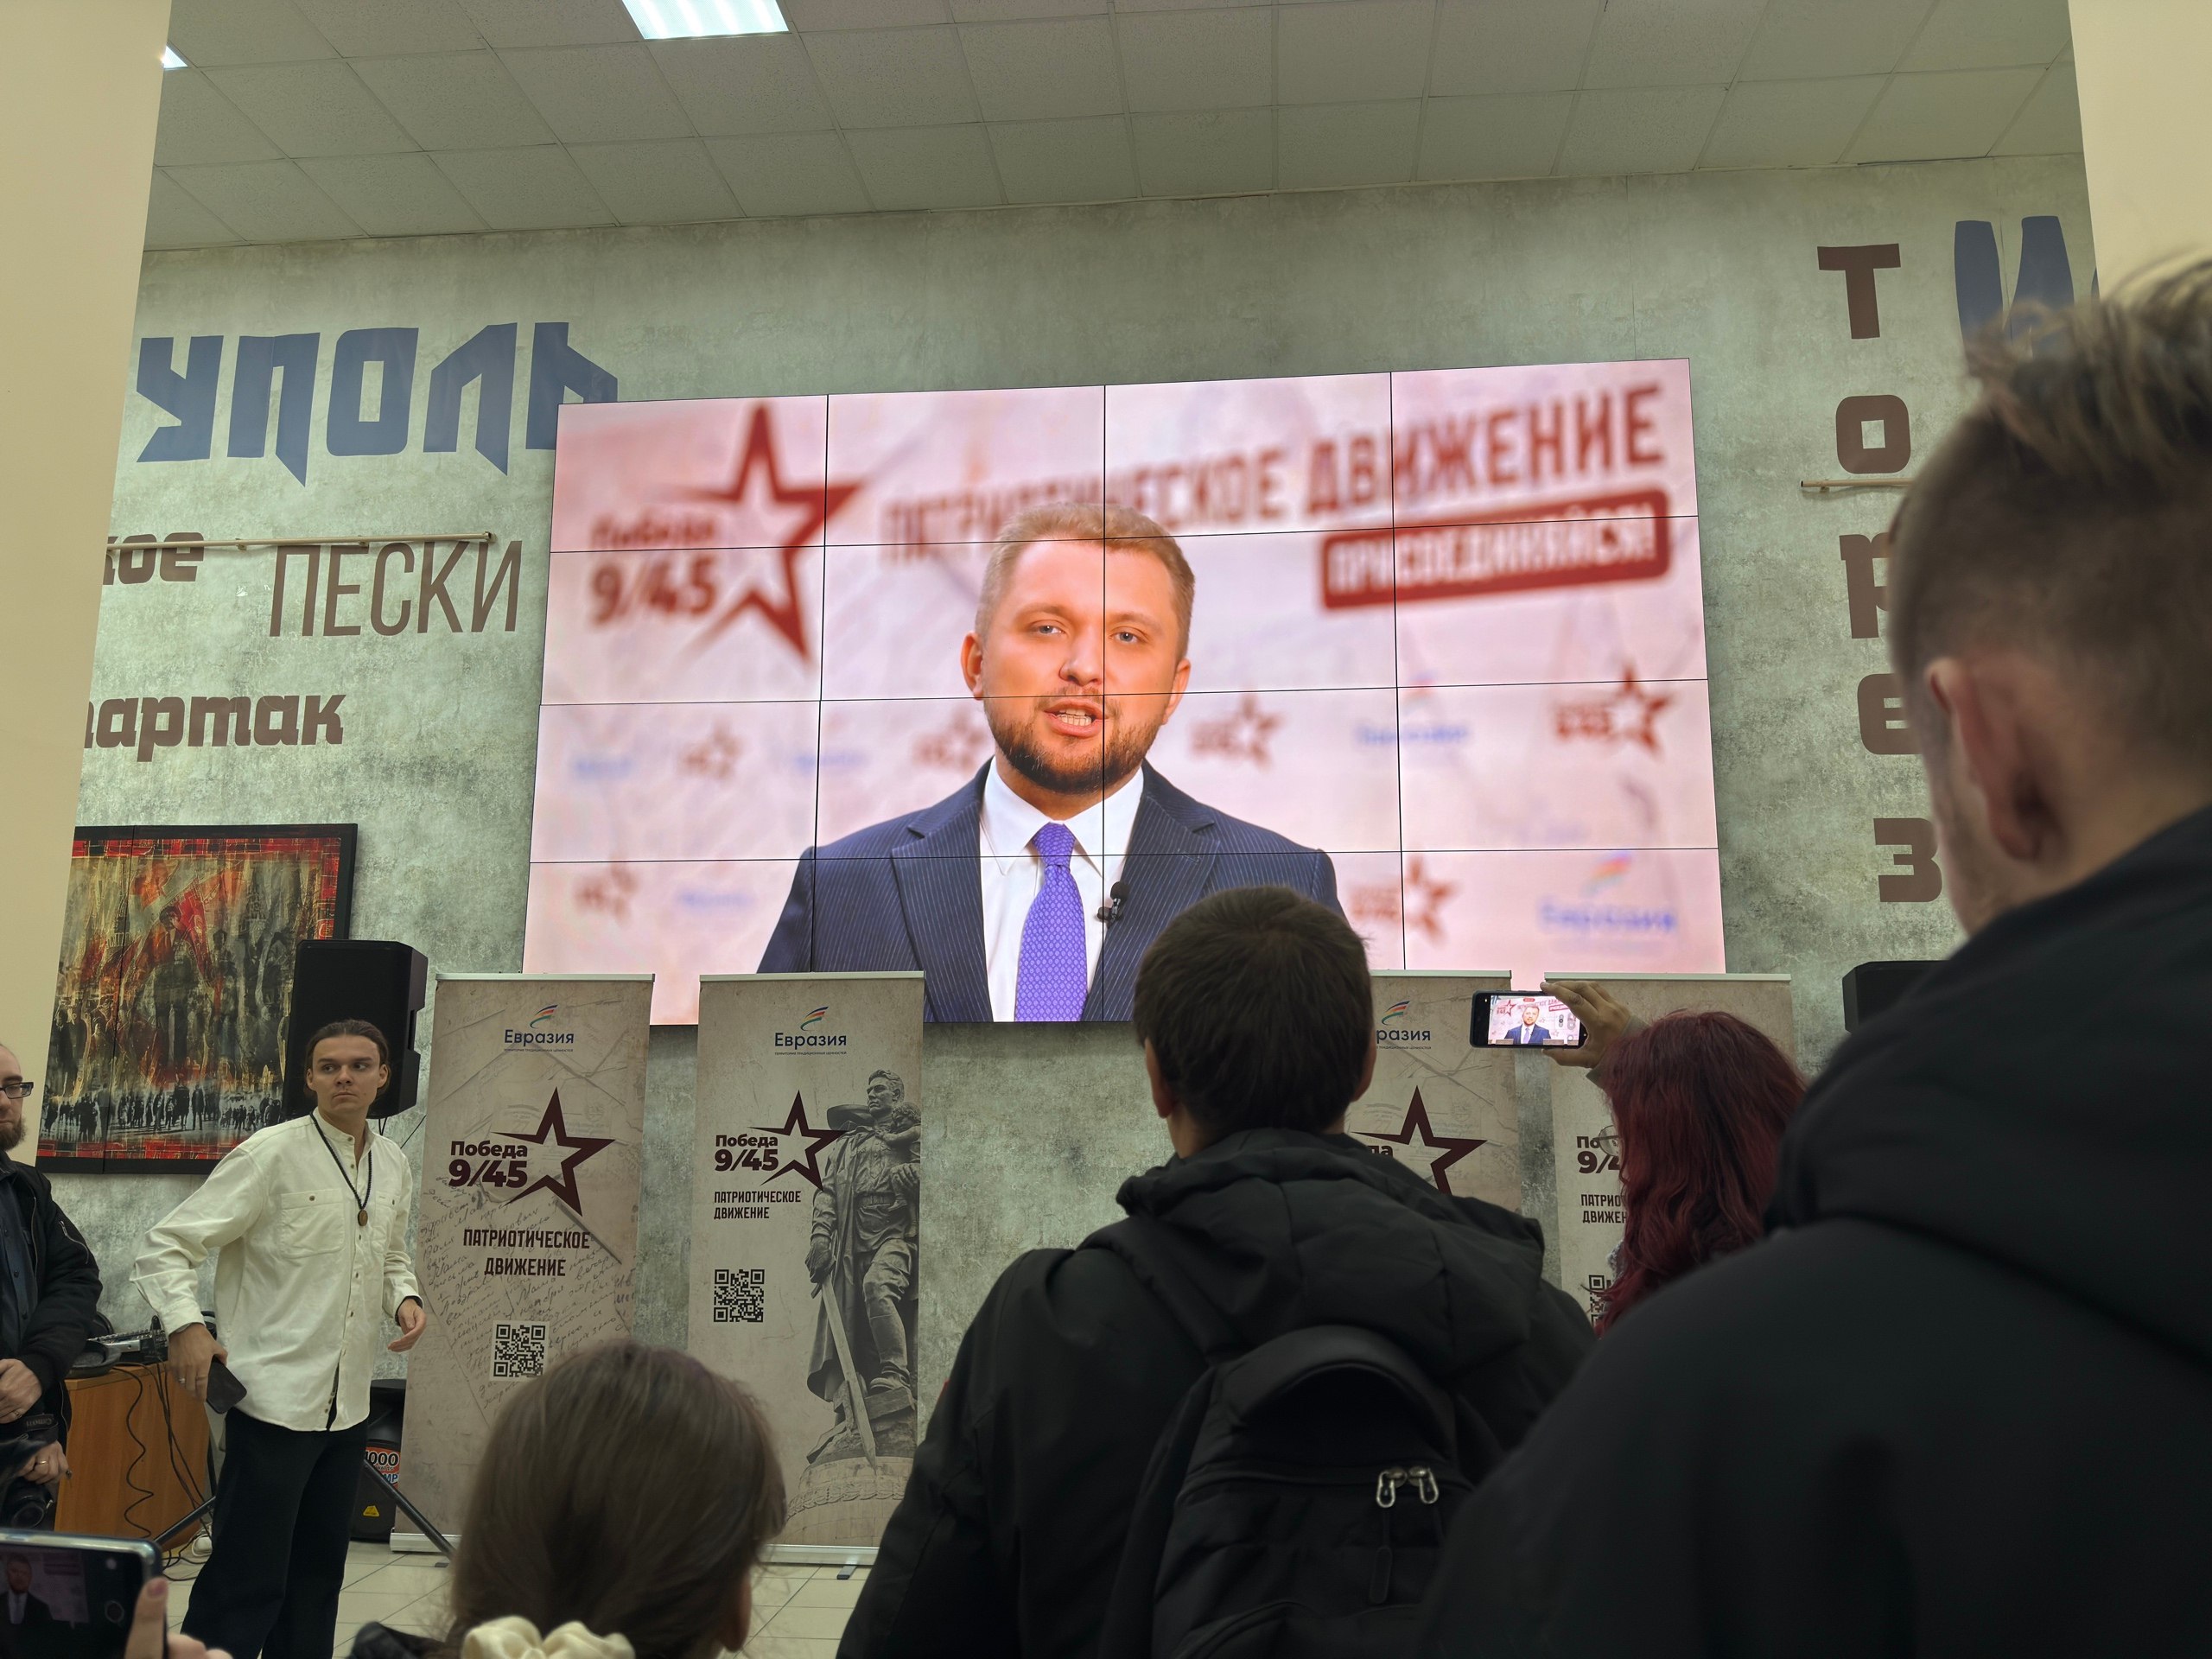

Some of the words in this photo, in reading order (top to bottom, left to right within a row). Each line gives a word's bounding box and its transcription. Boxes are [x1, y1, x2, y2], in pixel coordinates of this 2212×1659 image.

[1306, 383, 1663, 517] ДВИЖЕНИЕ
[269, 540, 524, 637] ПЕСКИ
[592, 554, 717, 626] 9/45
[504, 1029, 575, 1046] Евразия
[774, 1033, 847, 1050] Евразия
[1376, 1029, 1431, 1044] разия
[715, 1134, 778, 1147] Победа
[451, 1141, 528, 1159] Победа
[715, 1148, 779, 1172] 9/45
[448, 1159, 528, 1188] 9/45
[714, 1191, 801, 1203] ПАТРИОТИЧЕСКОЕ
[714, 1207, 770, 1219] ДВИЖЕНИЕ
[463, 1229, 590, 1249] ПАТРИОТИЧЕСКОЕ
[484, 1257, 567, 1276] ДВИЖЕНИЕ
